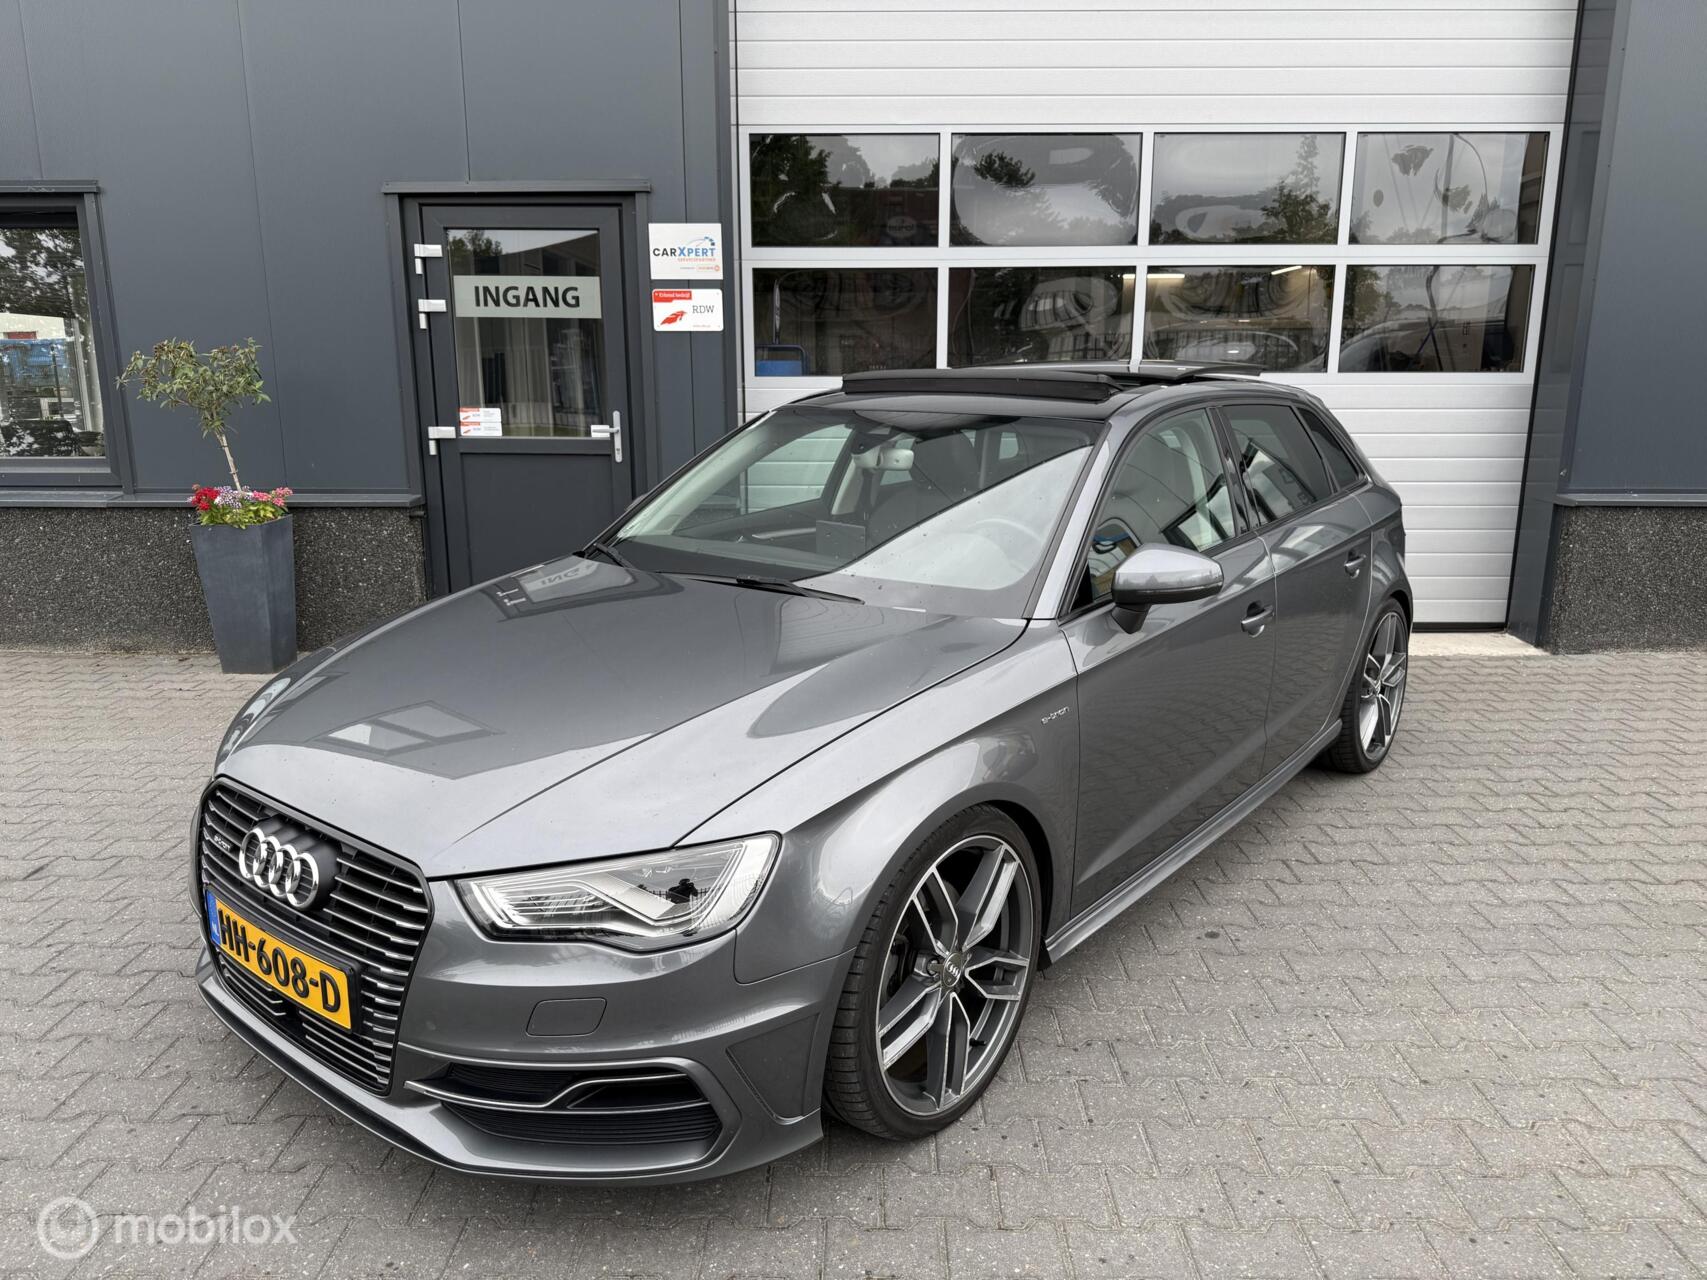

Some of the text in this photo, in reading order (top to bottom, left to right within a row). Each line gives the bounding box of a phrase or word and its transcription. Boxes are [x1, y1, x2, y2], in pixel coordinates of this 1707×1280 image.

[652, 246, 716, 257] CARXPERT
[474, 285, 580, 308] INGANG
[692, 305, 715, 314] RDW
[217, 908, 341, 1013] HH-608-D
